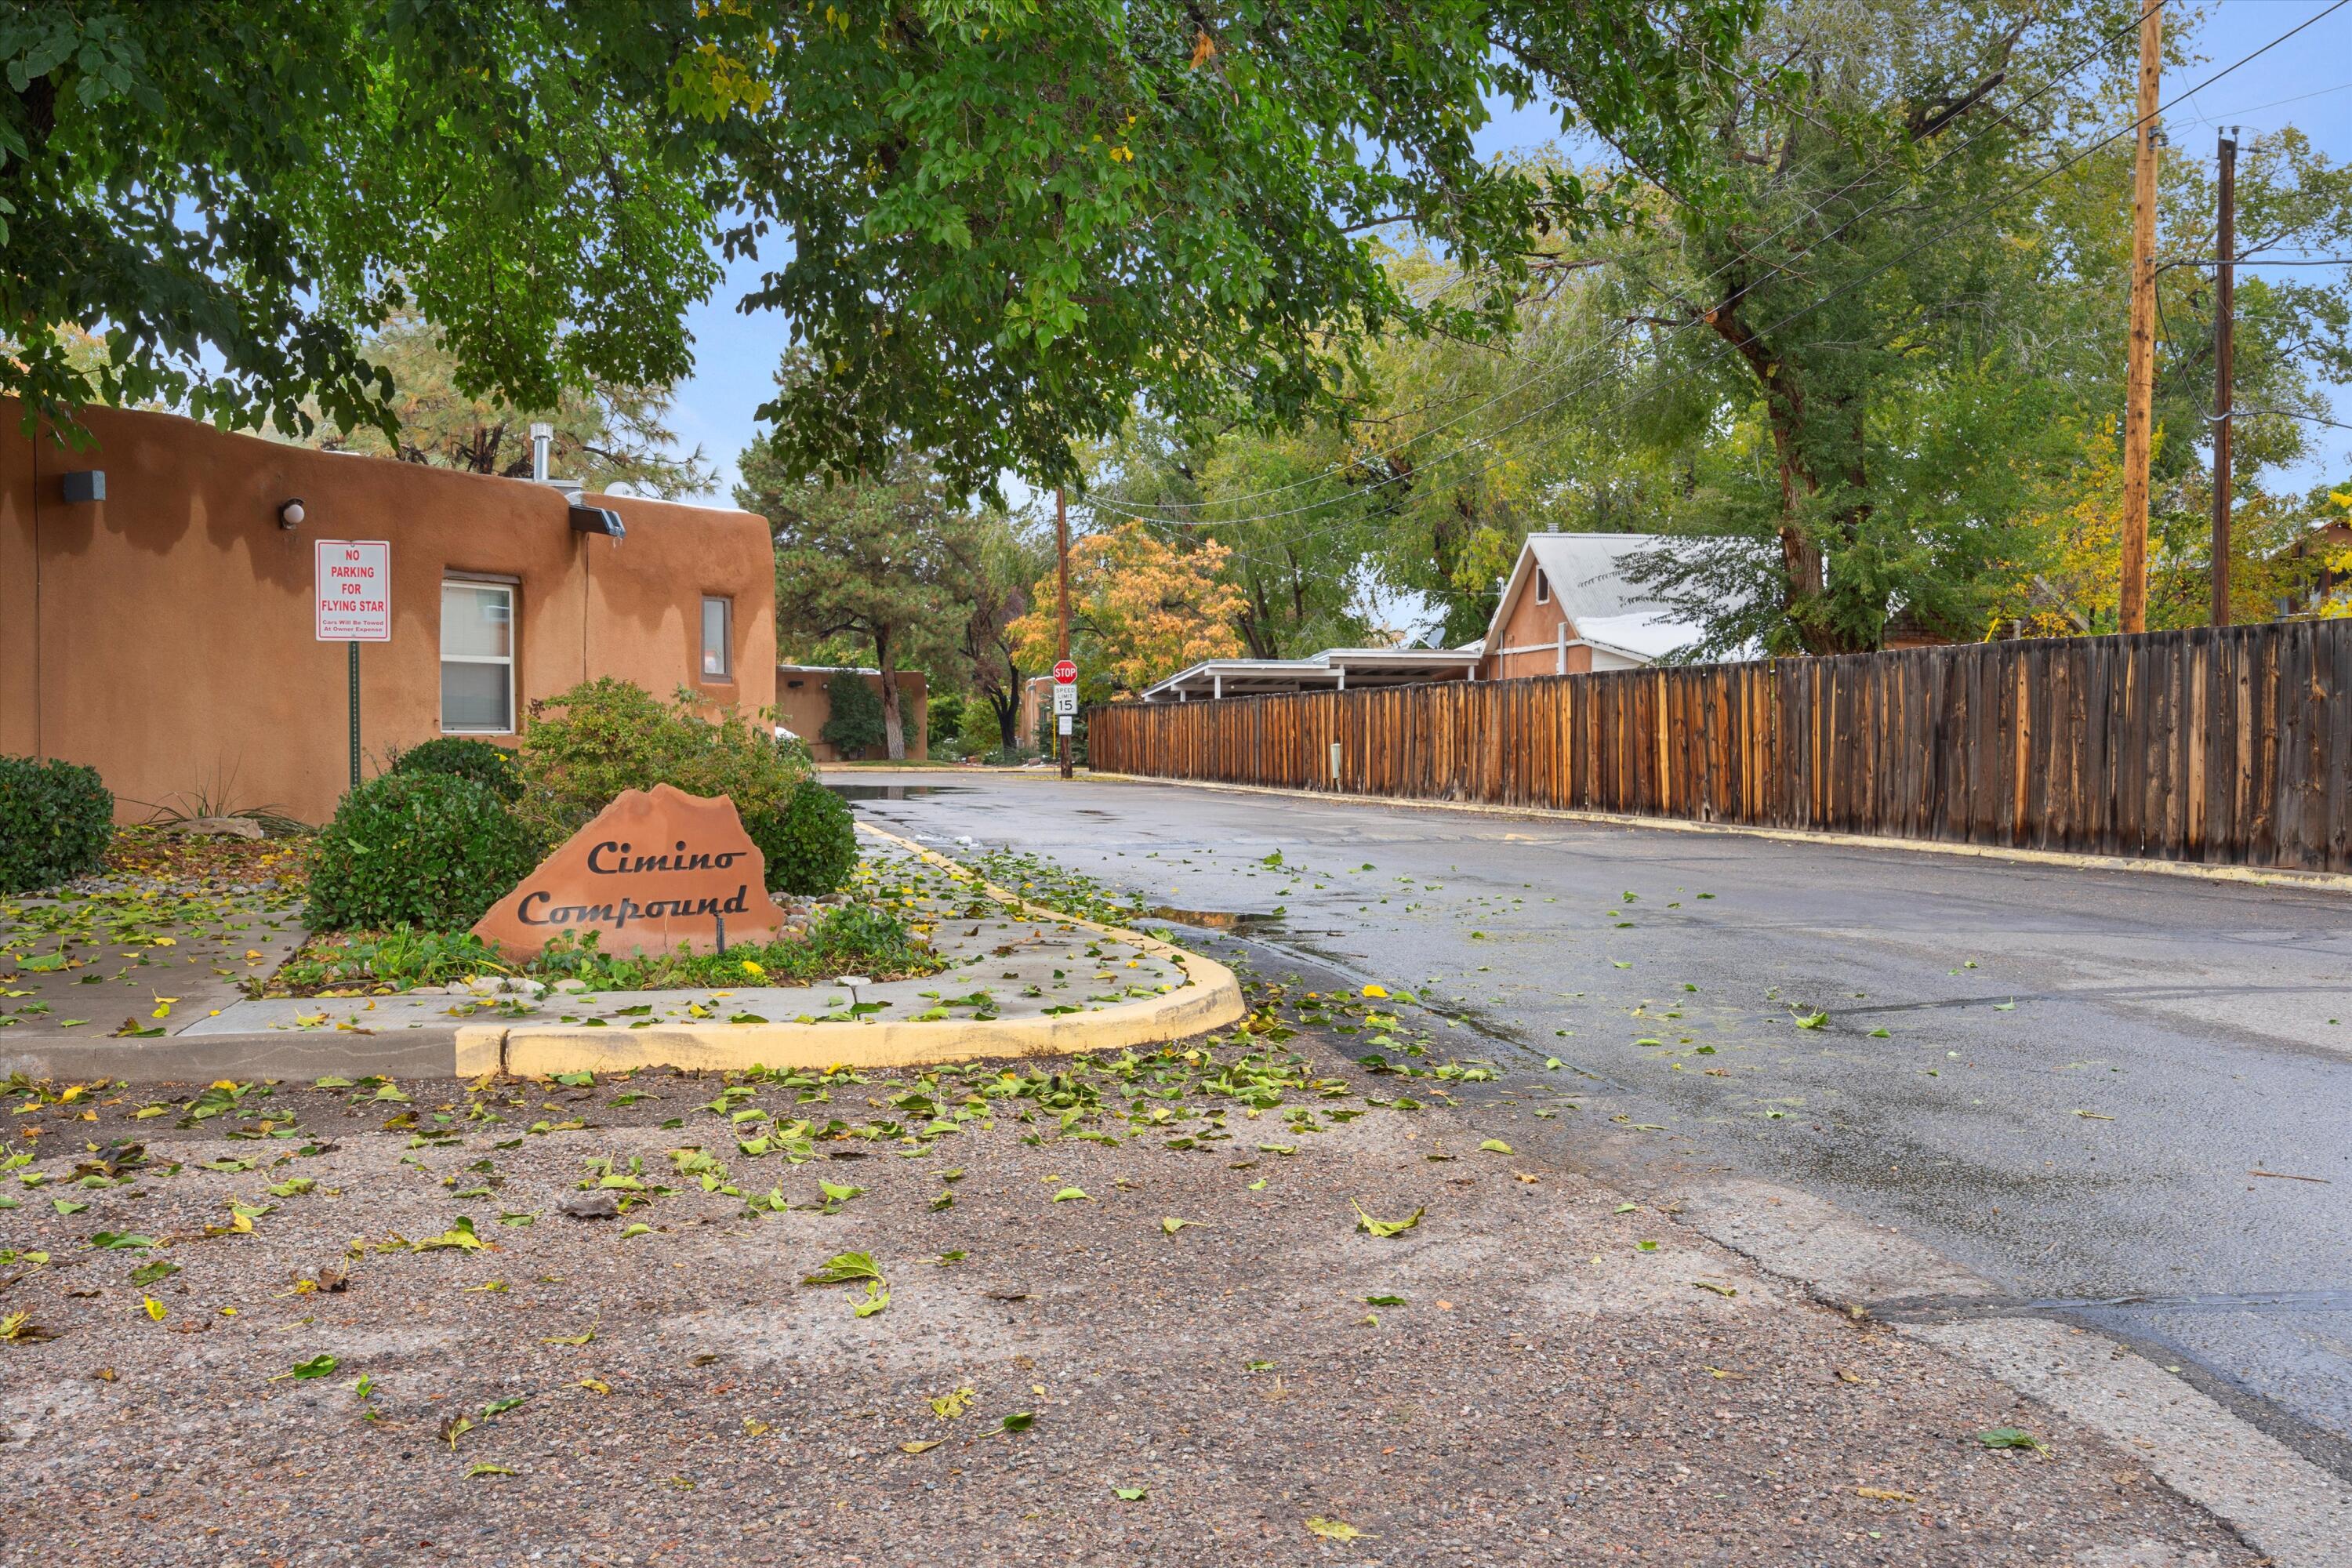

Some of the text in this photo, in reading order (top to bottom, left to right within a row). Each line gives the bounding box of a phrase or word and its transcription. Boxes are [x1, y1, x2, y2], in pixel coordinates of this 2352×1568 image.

[346, 550, 359, 561] NO
[332, 567, 374, 578] PARKING
[342, 583, 361, 594] FOR
[321, 601, 384, 612] FLYING STAR
[1055, 668, 1076, 677] STOP
[1059, 700, 1073, 710] 15
[587, 840, 747, 874] Cimino
[517, 884, 750, 928] Compound
